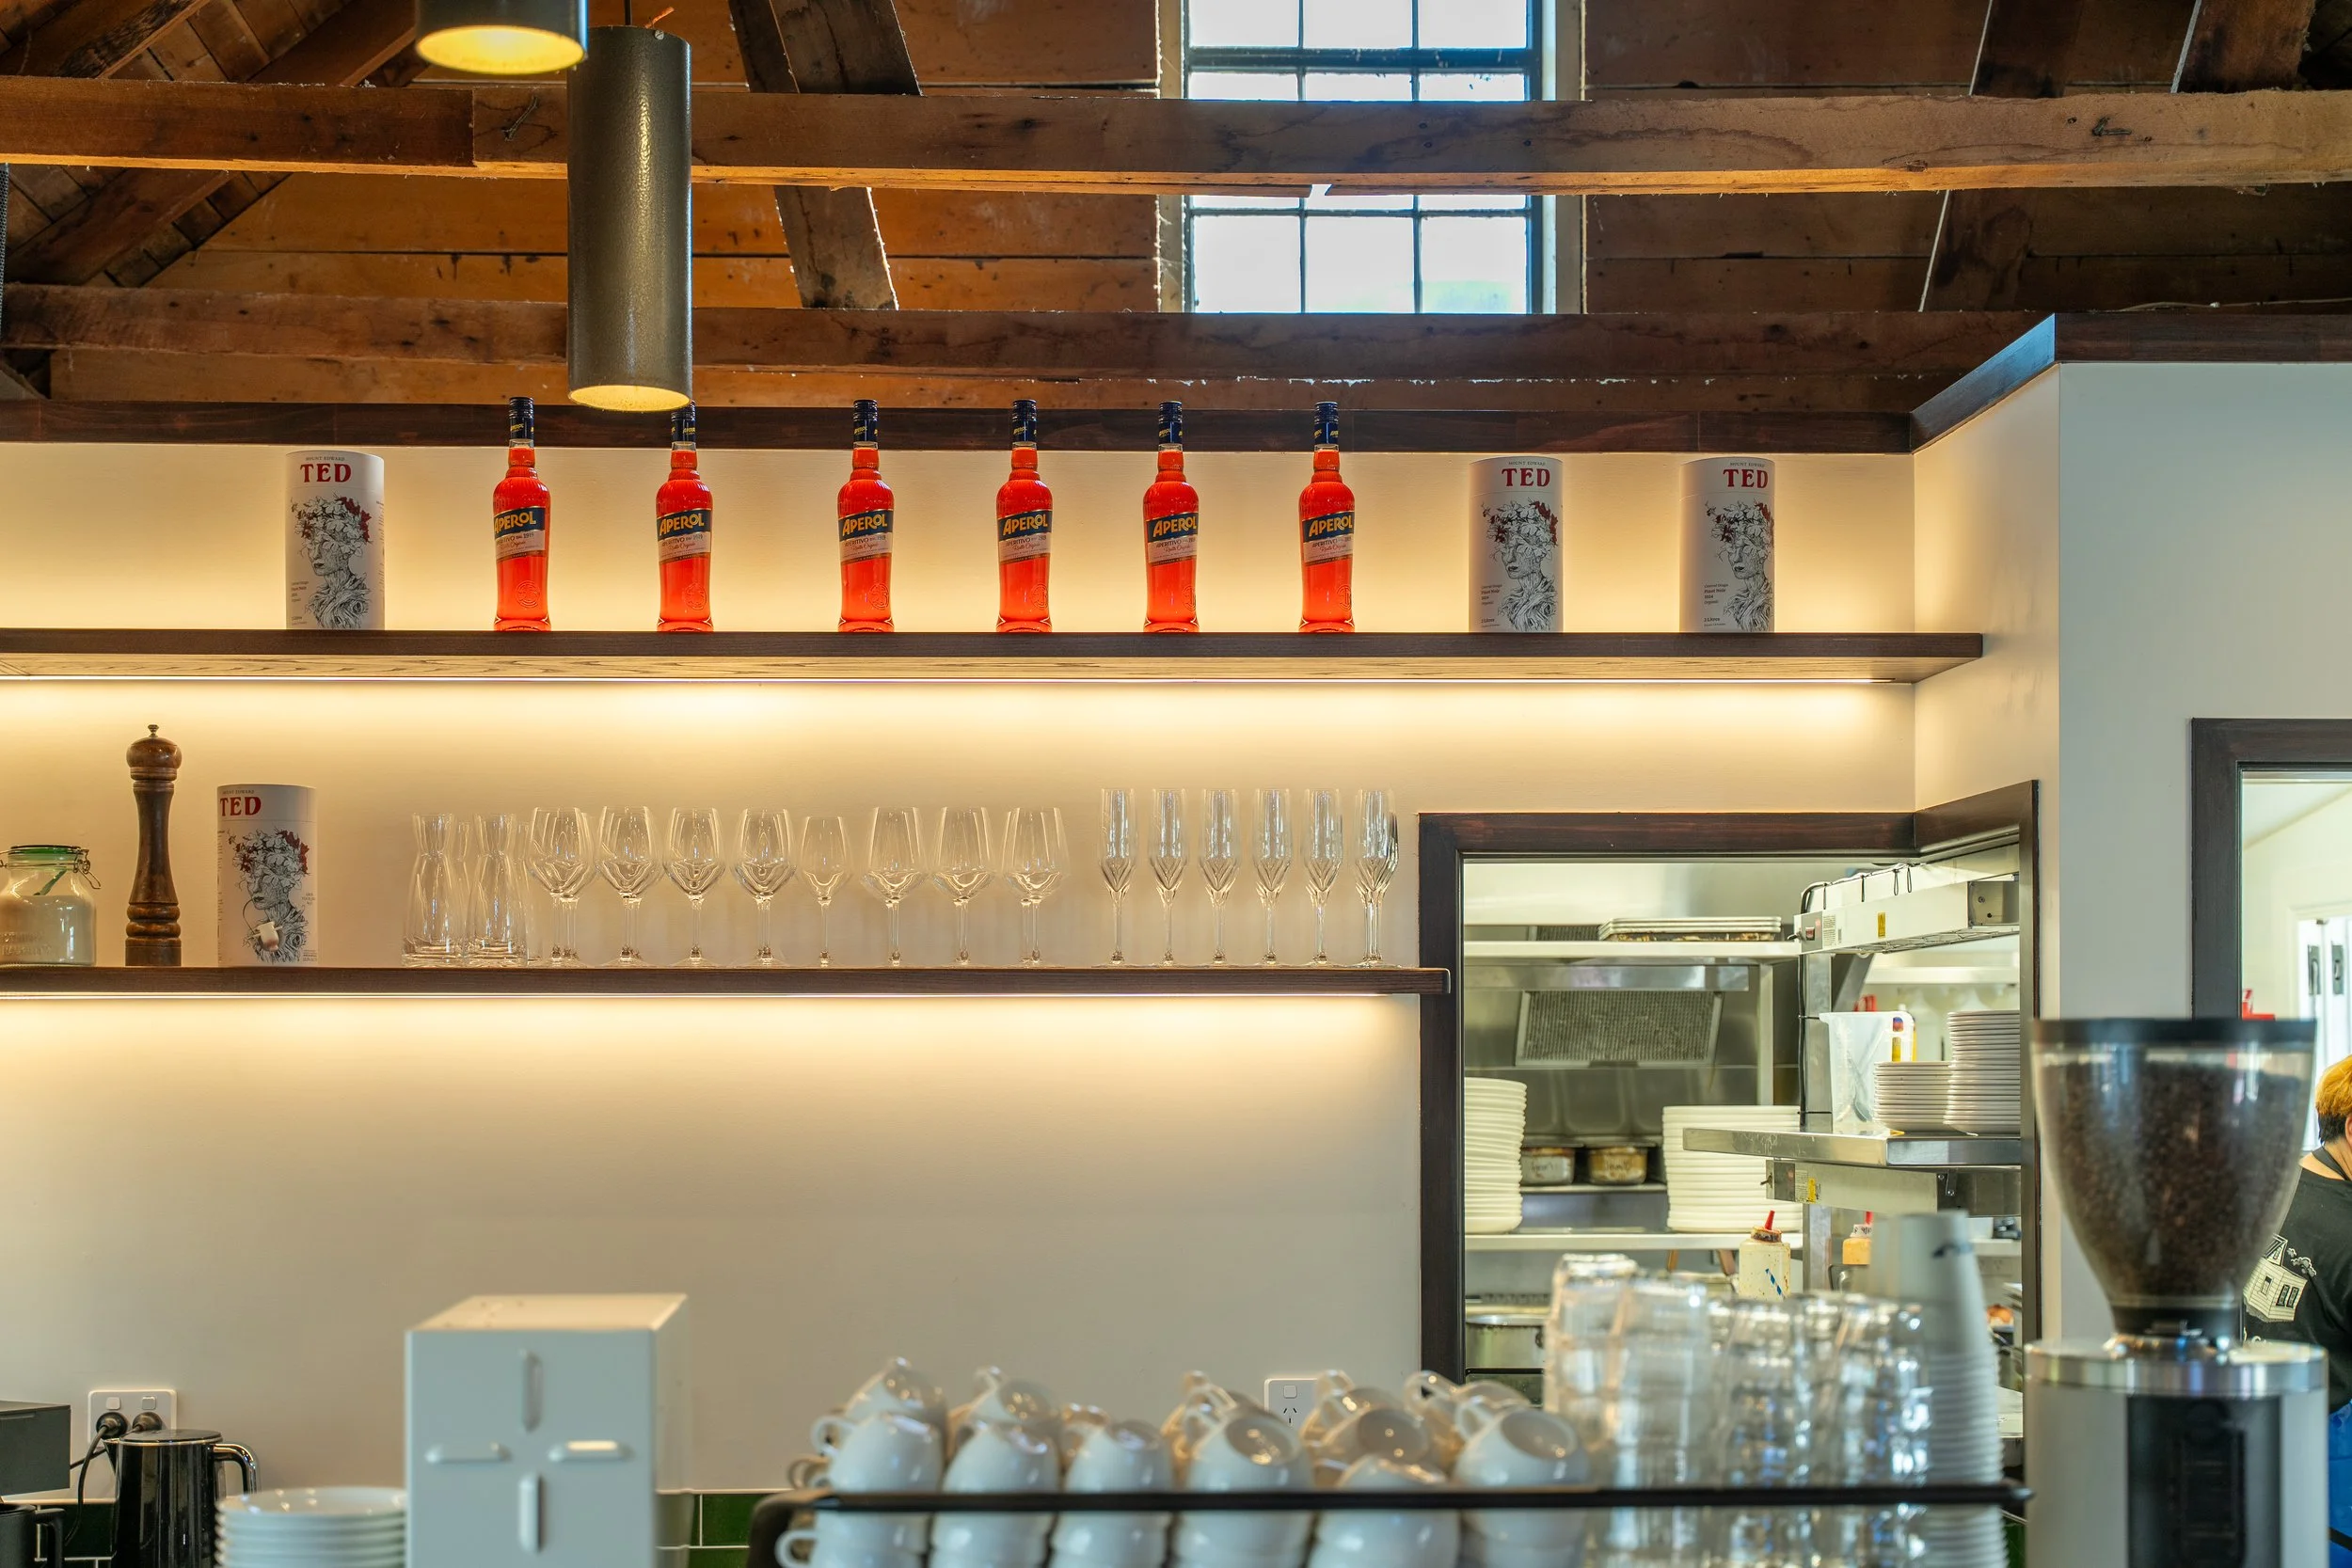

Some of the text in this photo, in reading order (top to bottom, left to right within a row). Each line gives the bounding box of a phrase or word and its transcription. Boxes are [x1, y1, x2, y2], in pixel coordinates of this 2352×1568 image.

[300, 464, 352, 483] TED
[1502, 467, 1550, 486] TED
[1723, 468, 1769, 488] TED
[494, 512, 537, 534] APEROL
[660, 513, 705, 536] APEROL
[842, 514, 888, 536] APEROL
[1002, 514, 1048, 536] APEROL
[1152, 515, 1198, 538] APEROL
[1308, 515, 1353, 537] APEROL
[219, 796, 262, 816] TED
